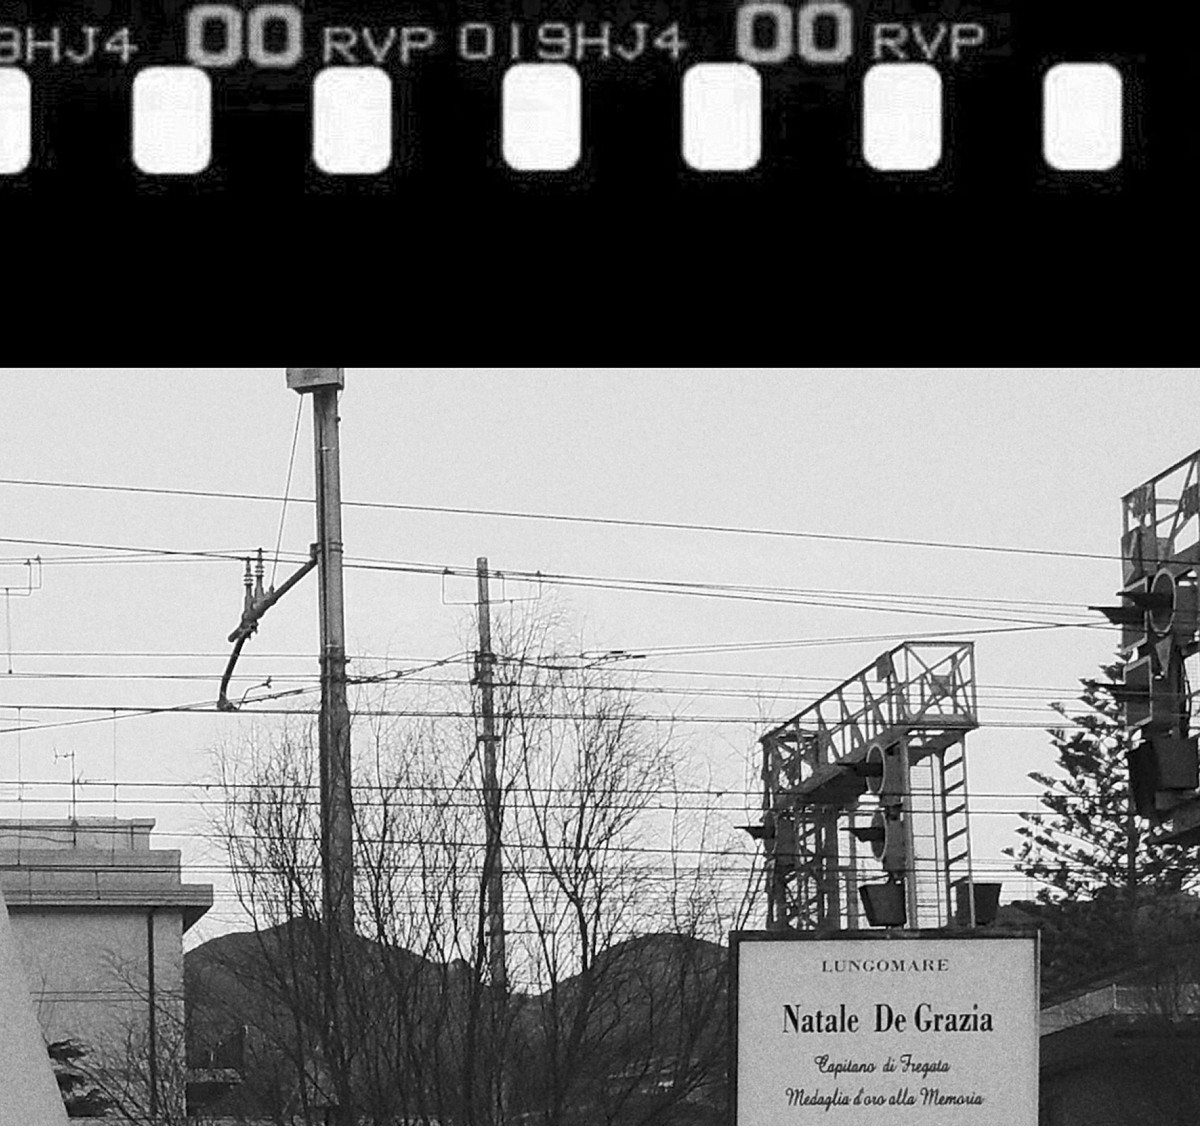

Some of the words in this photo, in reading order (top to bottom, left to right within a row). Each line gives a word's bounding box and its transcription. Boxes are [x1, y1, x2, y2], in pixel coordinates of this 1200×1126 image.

[822, 959, 949, 972] LUNGOMARE
[783, 1004, 859, 1033] Natale
[874, 1004, 906, 1032] De
[914, 1003, 993, 1032] Grazia
[814, 1054, 876, 1079] Capitano
[882, 1057, 897, 1073] di
[899, 1054, 951, 1079] Fregata
[785, 1088, 850, 1112] Medaglia
[853, 1087, 886, 1105] d'oro
[888, 1087, 917, 1105] alla
[920, 1087, 984, 1105] Memoria
